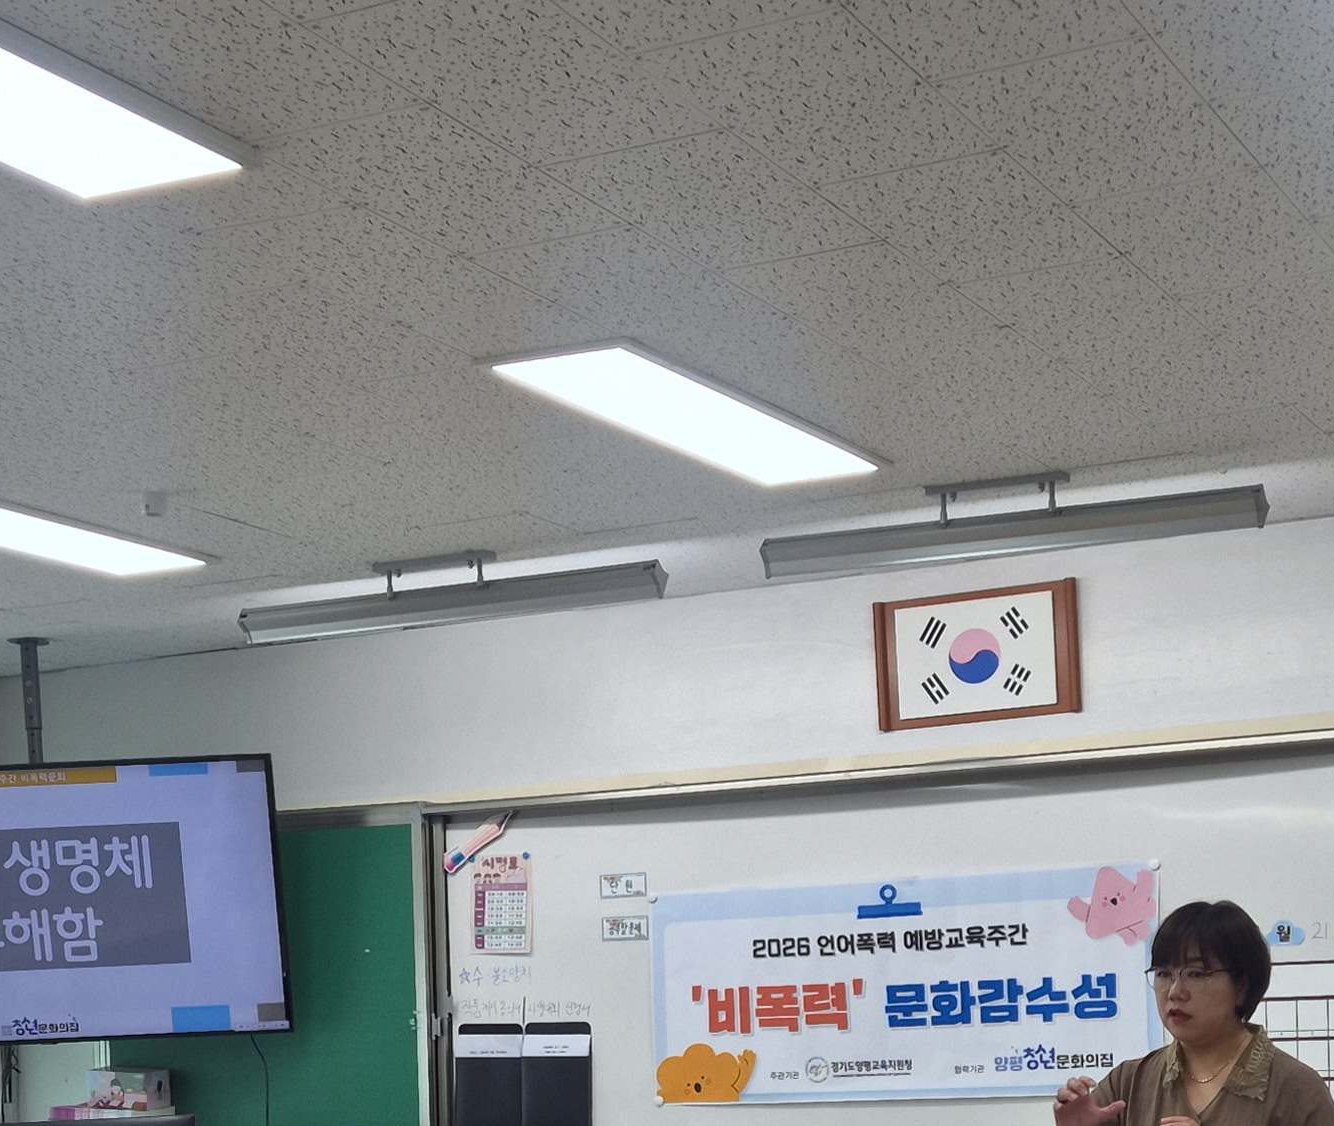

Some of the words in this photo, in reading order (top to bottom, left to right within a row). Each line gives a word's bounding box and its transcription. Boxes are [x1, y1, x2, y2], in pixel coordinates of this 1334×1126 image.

[2, 834, 154, 897] 생명체
[752, 937, 810, 959] 2026
[816, 931, 897, 957] 언어폭력
[902, 923, 1029, 952] 예방교육주간
[1276, 924, 1292, 943] 월
[1311, 921, 1328, 940] 21
[691, 978, 865, 1035] '비폭력'
[884, 973, 1118, 1028] 문화감수성
[769, 1071, 799, 1080] 주관기관
[831, 1059, 913, 1073] 경기도양평교육지원청
